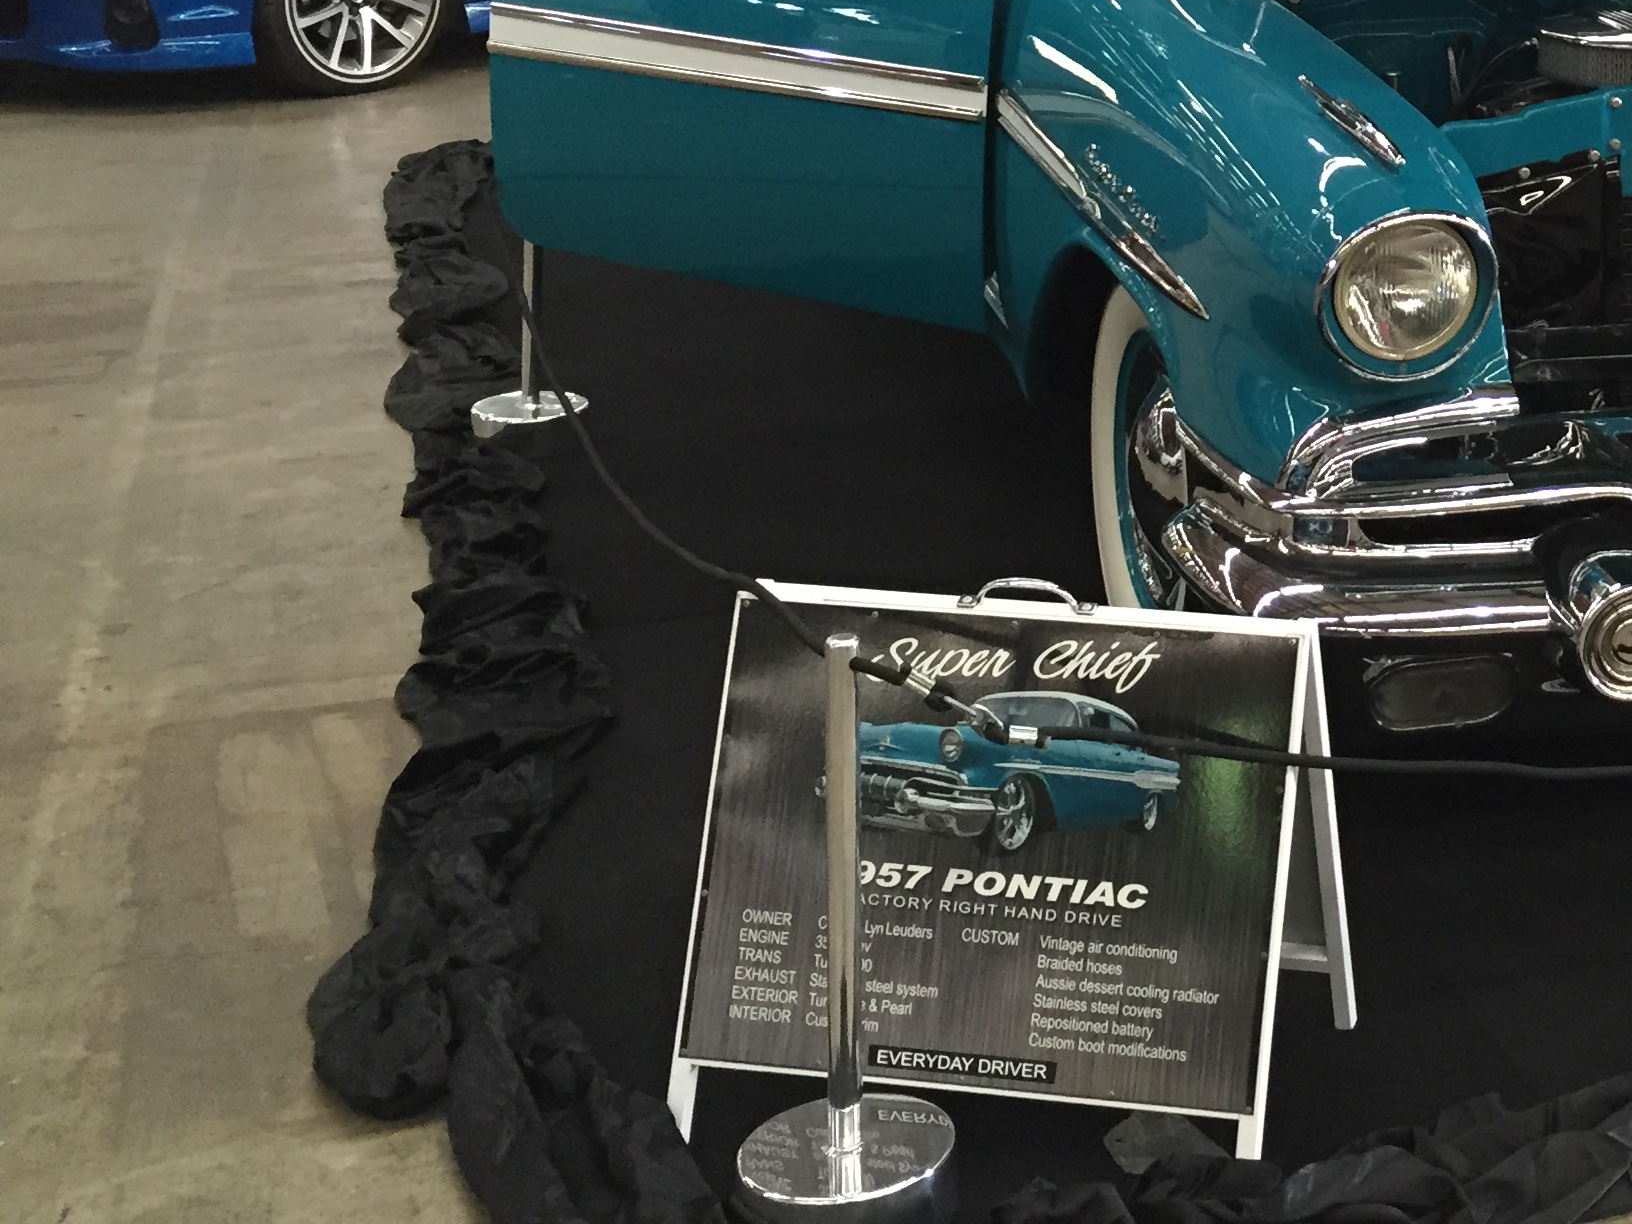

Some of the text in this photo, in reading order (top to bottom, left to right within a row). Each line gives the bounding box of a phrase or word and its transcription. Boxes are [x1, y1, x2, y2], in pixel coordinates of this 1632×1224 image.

[867, 637, 1162, 694] Super Chief
[861, 861, 1149, 909] 957 PONTIAC
[742, 908, 793, 926] OWNER
[861, 893, 1122, 928] CTORY RIGHT HAND DRIVE
[739, 928, 790, 946] ENGINE
[864, 919, 933, 940] Lyn Leuders
[961, 927, 1020, 946] CUSTOM
[738, 947, 782, 965] TRANS
[1040, 934, 1178, 964] Vintage air conditioning
[734, 966, 797, 985] EXHAUST
[1037, 954, 1123, 976] Braided hoses
[731, 985, 799, 1005] EXTERIOR
[865, 979, 939, 999] steel system
[1035, 974, 1220, 1005] Aussie dessert cooling radiator
[729, 1004, 792, 1024] INTERIOR
[868, 998, 878, 1013] &
[880, 1000, 913, 1016] Pearl
[1033, 993, 1163, 1020] Stainless steel covers
[1031, 1013, 1154, 1041] Repositioned battery
[1028, 1033, 1187, 1062] Custom boot modifications
[876, 1049, 1047, 1080] EVERYDAY DRIVER
